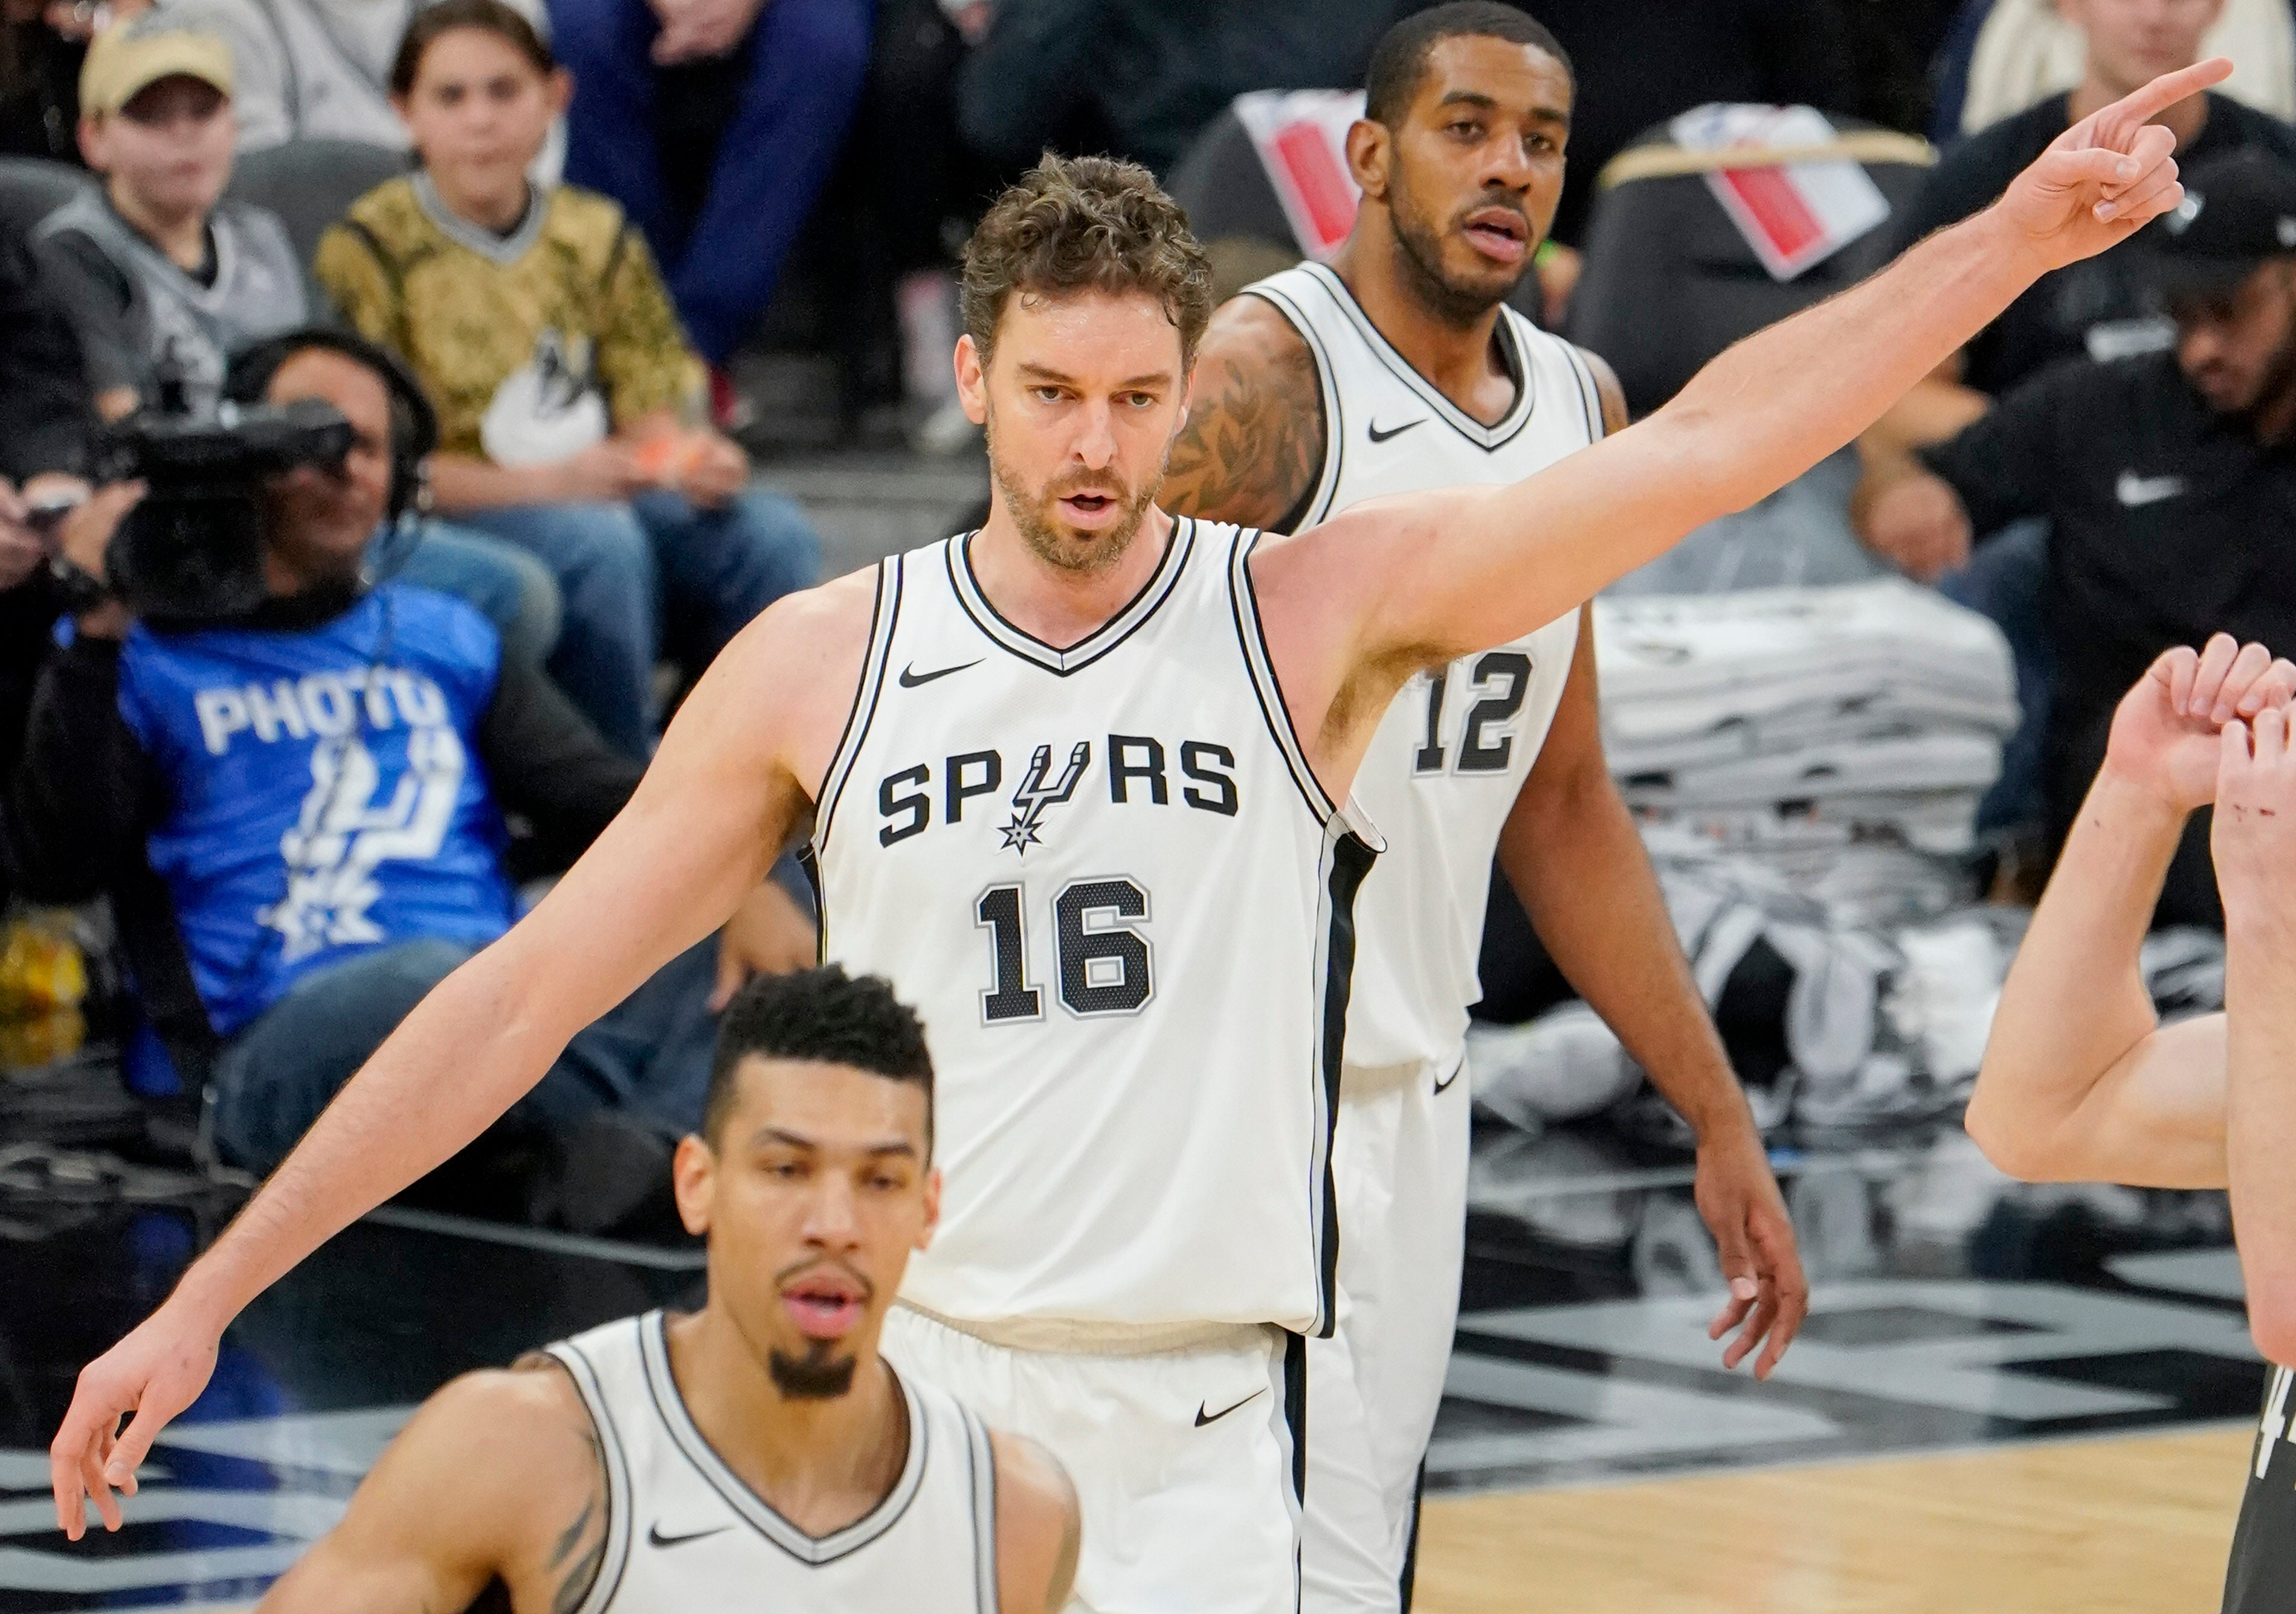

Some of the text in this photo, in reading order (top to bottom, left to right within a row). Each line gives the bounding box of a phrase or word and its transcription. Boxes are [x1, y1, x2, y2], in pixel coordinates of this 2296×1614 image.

[195, 666, 448, 755] PHOTO
[1410, 649, 1537, 777] 12
[879, 733, 1239, 856] SPURS
[973, 873, 1157, 1029] 16
